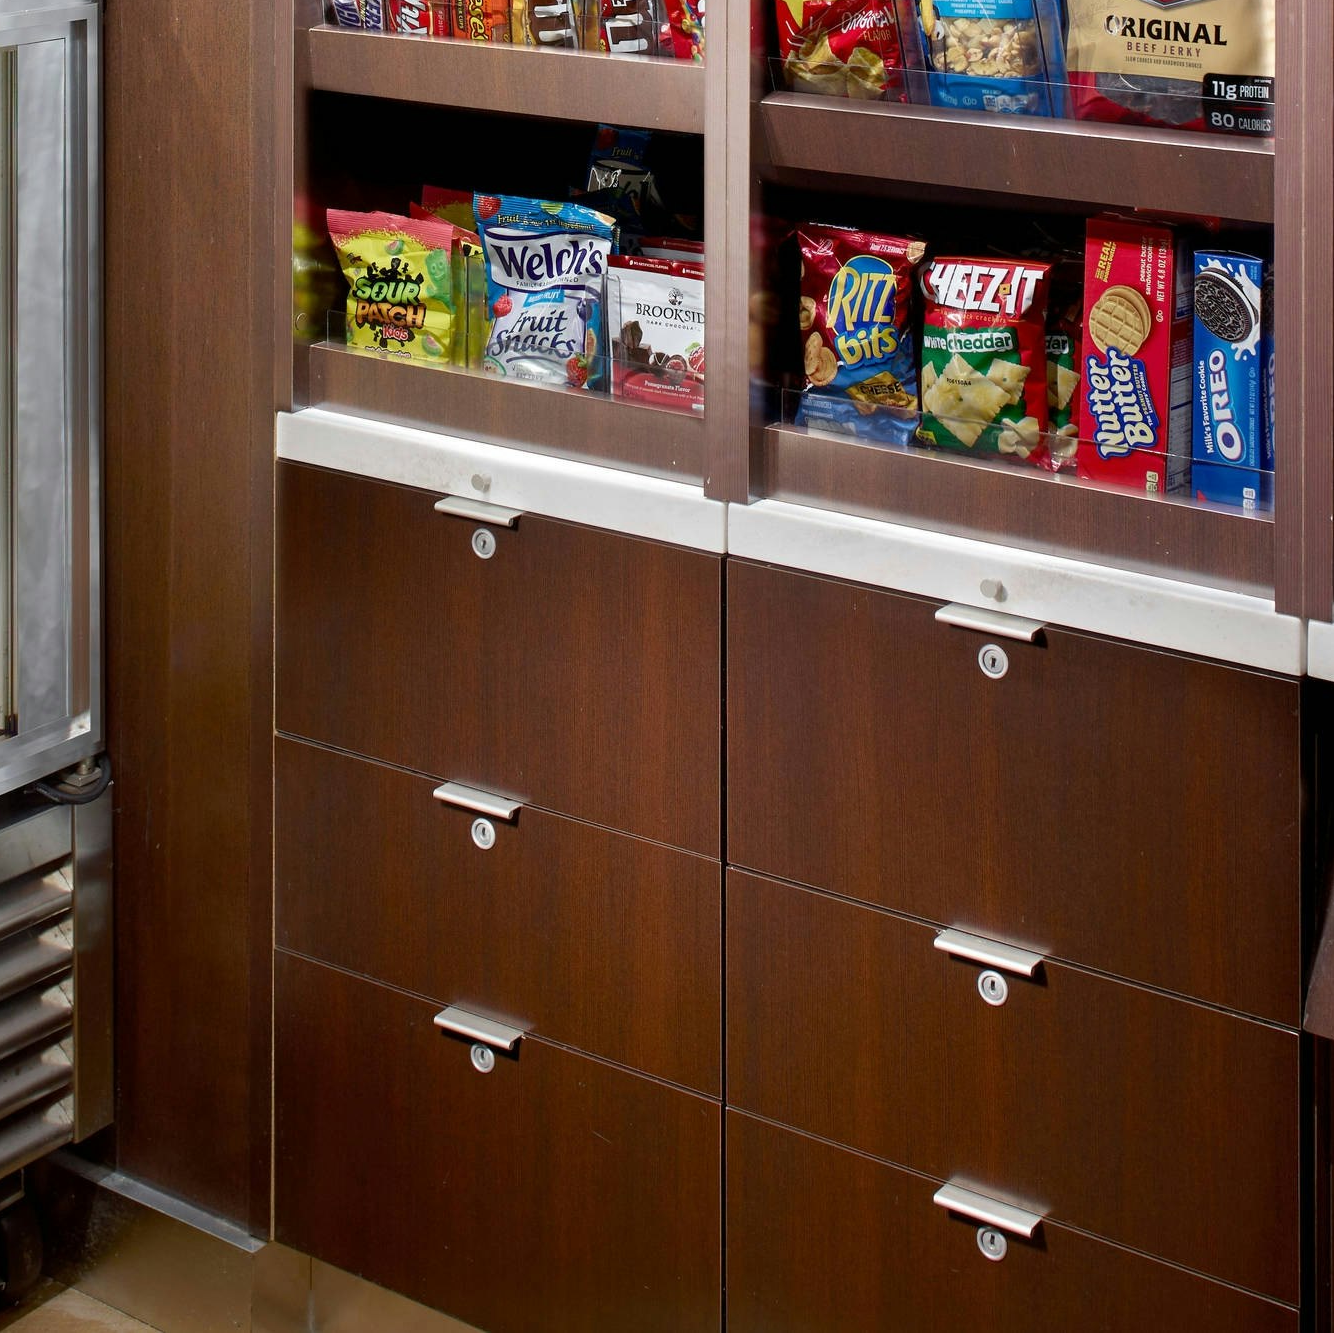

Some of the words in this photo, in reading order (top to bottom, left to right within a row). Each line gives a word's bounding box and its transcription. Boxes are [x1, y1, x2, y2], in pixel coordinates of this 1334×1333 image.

[863, 29, 891, 42] FLAVOR
[1105, 15, 1227, 46] ORIGINAL
[1127, 42, 1157, 53] BEEF
[1163, 45, 1202, 57] JERKY
[1212, 80, 1237, 100] 11g
[1240, 85, 1269, 99] PROTEIN
[1211, 112, 1234, 128] 80
[1239, 118, 1271, 131] CALORIES
[491, 240, 603, 281] Welch's
[1099, 241, 1112, 266] REAL
[356, 277, 420, 305] SOUR
[827, 266, 896, 331] RITZ
[356, 301, 426, 328] PATCH
[511, 308, 568, 333] Fruit
[383, 326, 408, 341] Kids
[490, 327, 577, 358] Snacks
[837, 326, 898, 365] bits
[859, 382, 902, 396] CHEESE
[1109, 351, 1154, 446] Butter
[1090, 357, 1130, 459] Nutter
[1201, 390, 1212, 423] Favorite
[1209, 351, 1242, 460] OREO
[1205, 425, 1214, 454] Milk's
